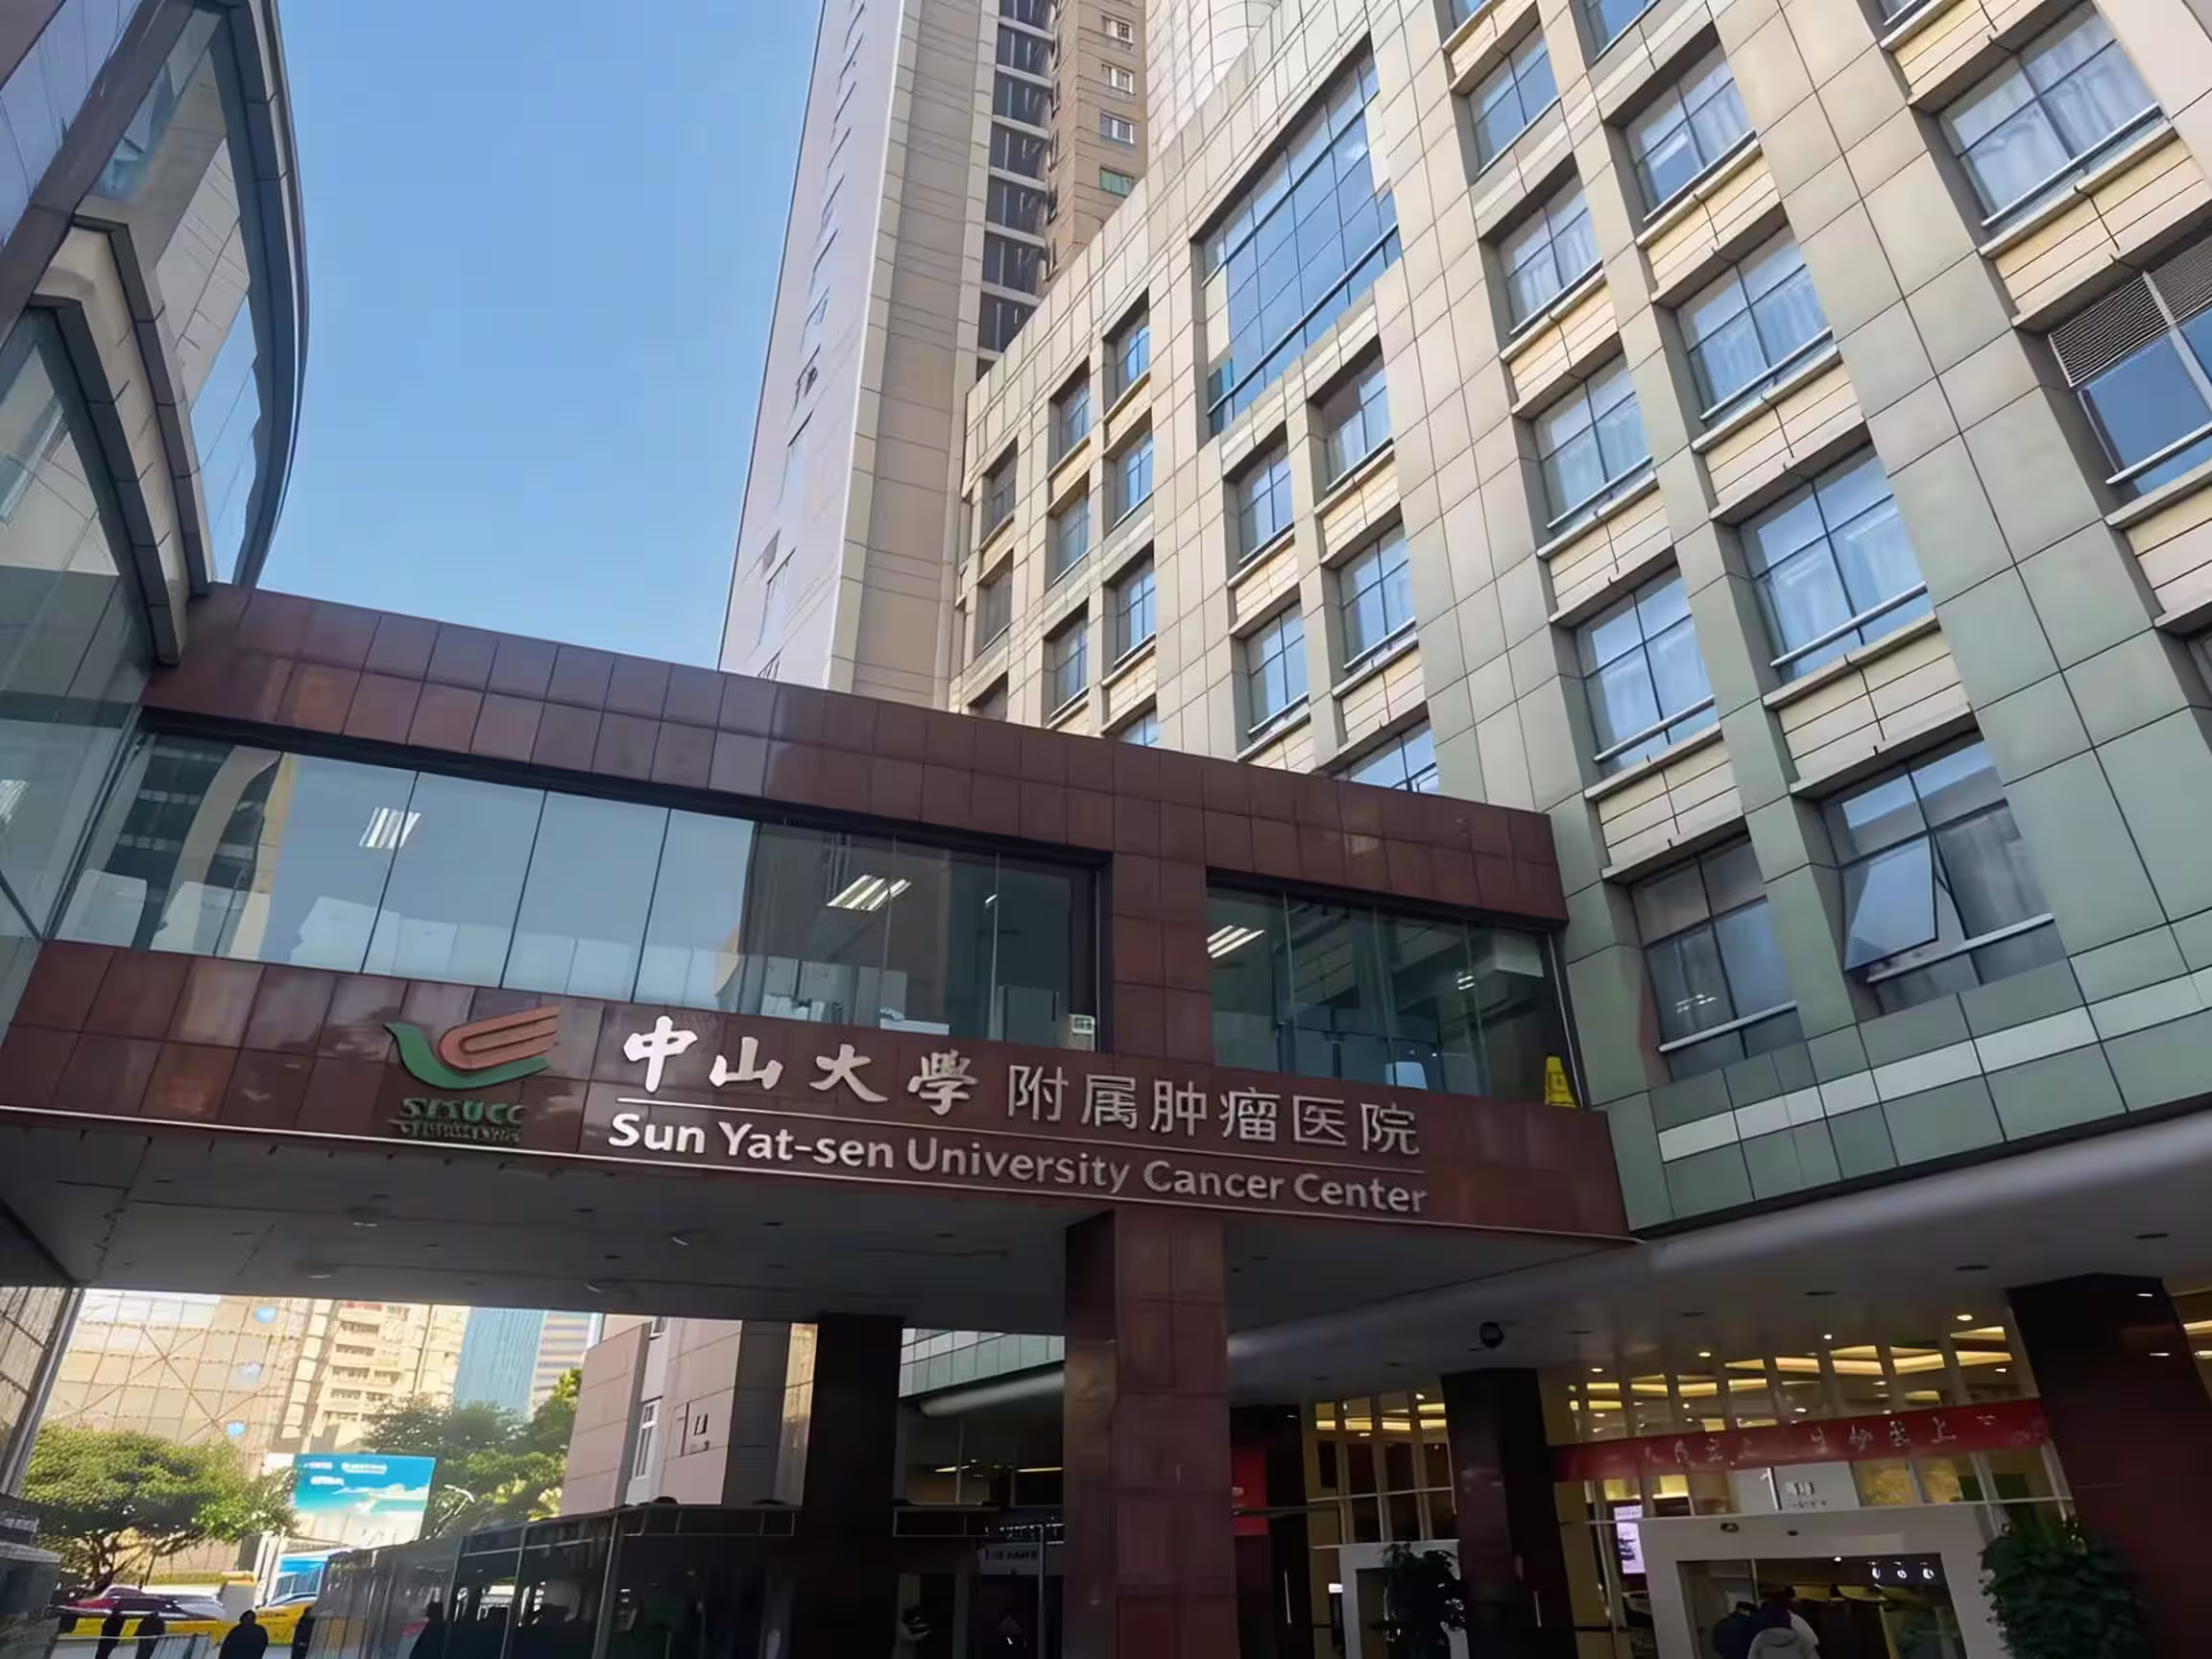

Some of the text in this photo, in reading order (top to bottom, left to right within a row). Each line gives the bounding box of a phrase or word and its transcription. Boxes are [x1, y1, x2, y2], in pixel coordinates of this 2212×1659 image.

[623, 1015, 1420, 1154] 中山大學附属肿瘤医院
[608, 1113, 1428, 1213] Sun Yat-sen University Cancer Center
